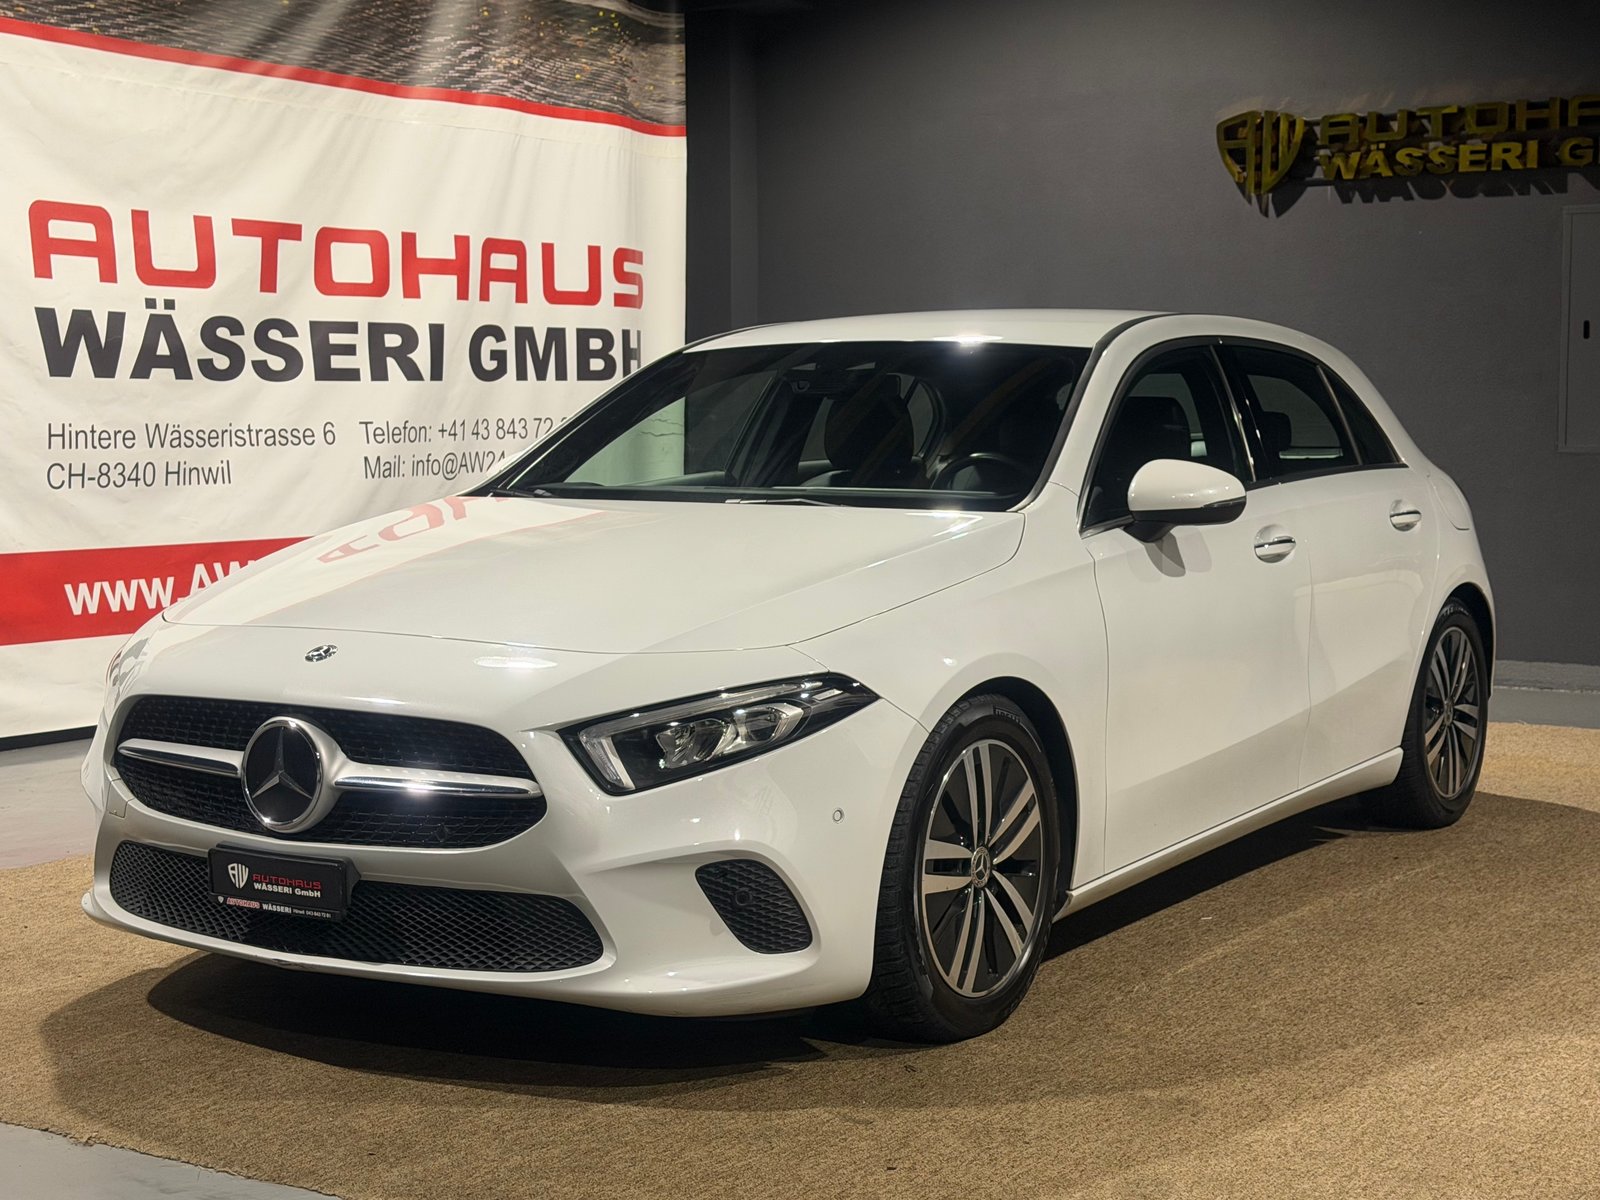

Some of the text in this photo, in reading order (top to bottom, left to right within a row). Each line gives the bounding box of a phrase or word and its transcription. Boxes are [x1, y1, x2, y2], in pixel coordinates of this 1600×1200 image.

[1320, 139, 1538, 180] WÄSSERI
[28, 199, 644, 309] AUTOHAUS
[34, 298, 642, 383] WÄSSERI GMBH
[47, 421, 336, 450] Hintere Wässeristrasse 6
[358, 417, 553, 444] Telefon: +41 43 843 72
[46, 459, 232, 490] CH-8340 Hinwil
[363, 454, 405, 479] Mail:
[252, 873, 322, 889] AUTOHAUS
[253, 882, 321, 898] WÄSSERI GmbH
